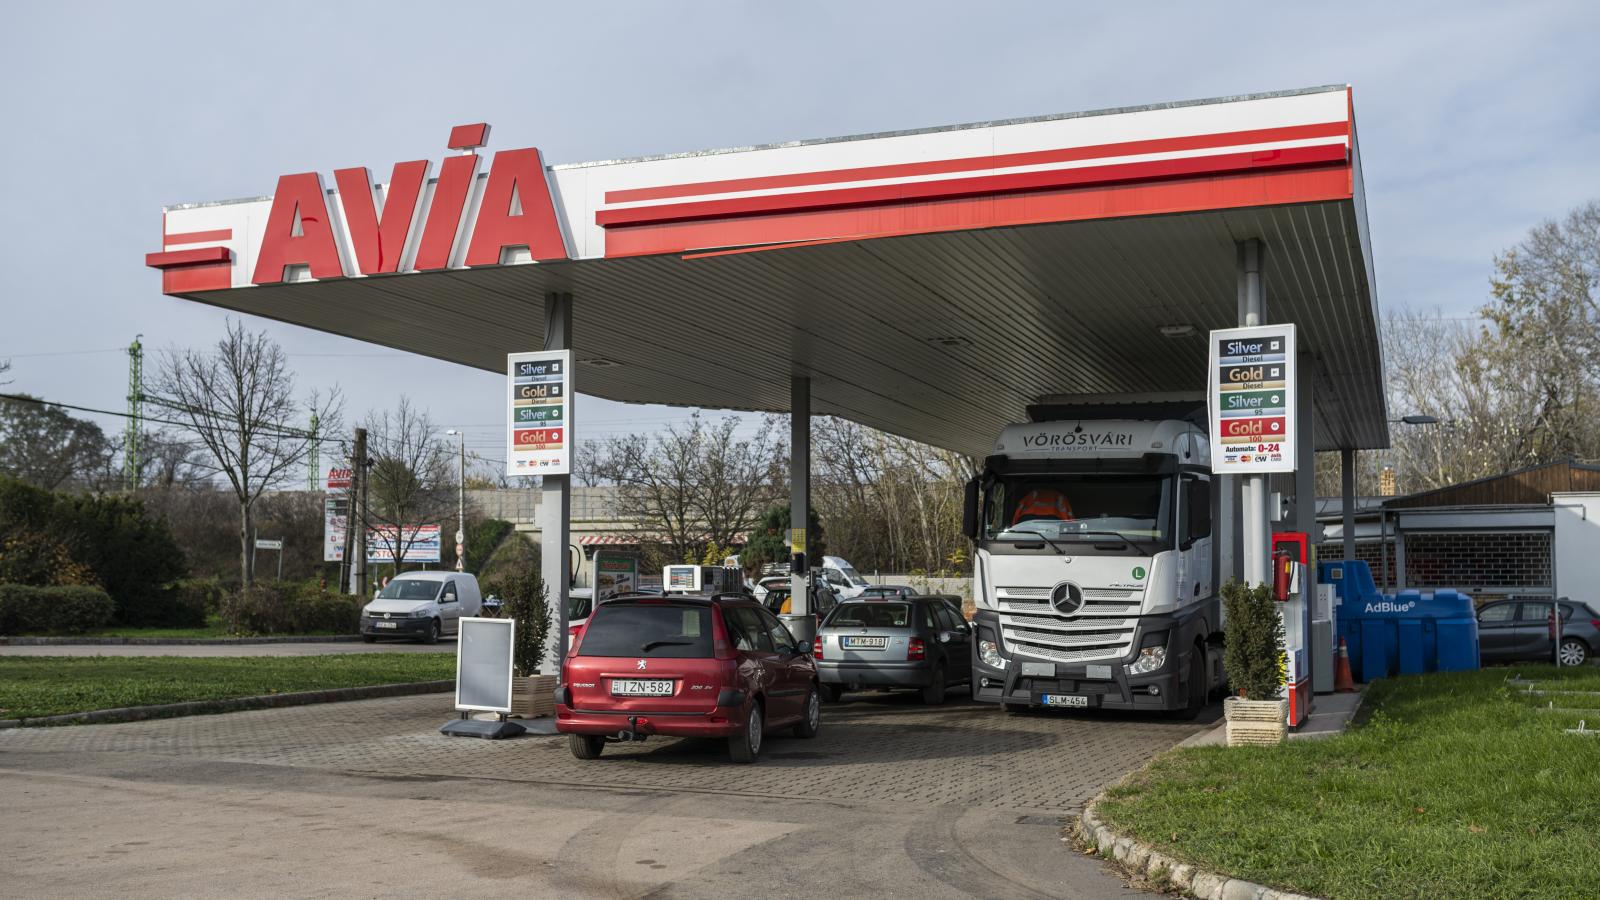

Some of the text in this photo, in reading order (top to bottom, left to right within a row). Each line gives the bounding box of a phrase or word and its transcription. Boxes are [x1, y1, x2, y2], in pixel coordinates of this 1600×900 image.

[1227, 341, 1263, 355] Silver
[1242, 355, 1263, 363] Diesel
[520, 364, 547, 376] Silver
[1229, 366, 1263, 381] Gold
[521, 385, 547, 398] Gold
[1228, 395, 1263, 408] Silver
[520, 409, 547, 420] Silver
[1229, 420, 1262, 435] Gold
[520, 431, 546, 443] Gold
[1023, 431, 1133, 447] VÖRÖSVÁRI
[1248, 435, 1262, 443] 100
[1225, 443, 1280, 453] Automata: 0-24
[623, 681, 671, 693] IZN-582
[1049, 695, 1086, 705] SLM-454
